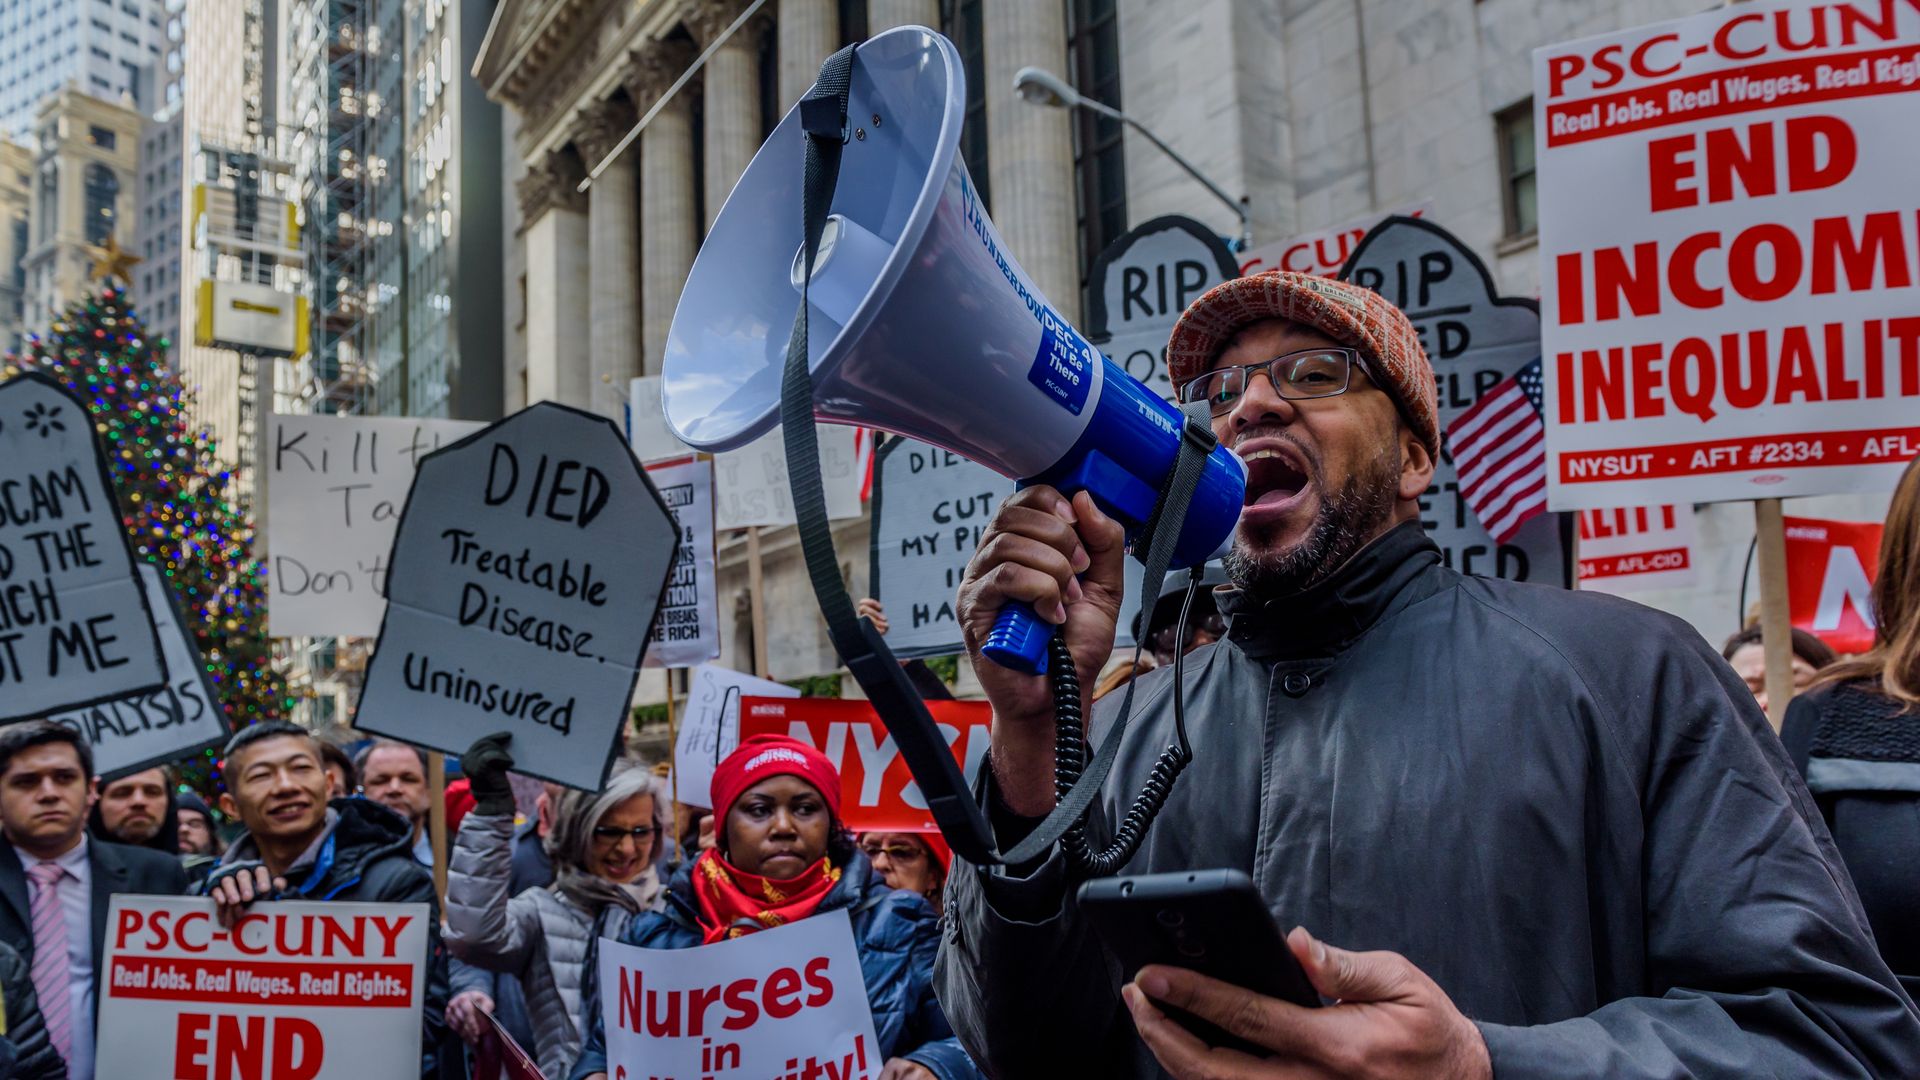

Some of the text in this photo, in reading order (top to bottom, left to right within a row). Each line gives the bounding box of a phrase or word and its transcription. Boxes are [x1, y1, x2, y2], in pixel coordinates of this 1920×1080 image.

[1552, 51, 1920, 136] Real Jobs. Real Wages. Real Rig
[1648, 114, 1857, 213] END
[968, 186, 1044, 324] THUNDERPOW
[1556, 209, 1920, 326] INCOM
[1122, 259, 1208, 322] RIP
[1044, 312, 1092, 364] DEC. 4
[1053, 340, 1083, 372] I'll Be
[1049, 351, 1080, 386] There
[1556, 316, 1920, 424] INEQUALIT
[276, 424, 378, 474] Kill
[1568, 436, 1920, 478] NYSUT AFT #2334 AFL-
[327, 483, 401, 528] Ta
[484, 442, 611, 528] DIED
[932, 491, 994, 524] CUT
[22, 522, 103, 574] THE
[901, 525, 987, 557] MY PI
[1616, 551, 1683, 574] AFL-CIO
[441, 528, 608, 608] Treatable
[0, 576, 62, 631] ICH
[459, 582, 606, 664] Disease.
[912, 601, 955, 628] HA
[48, 613, 130, 678] ME
[668, 624, 700, 641] RICH
[403, 652, 576, 737] Uninsured
[115, 908, 415, 958] PSC-CUNY
[113, 963, 407, 1002] Real Jobs. Real Wages. Real Rights.
[618, 956, 834, 1040] Nurses
[174, 1012, 325, 1080] END
[701, 1037, 741, 1074] in
